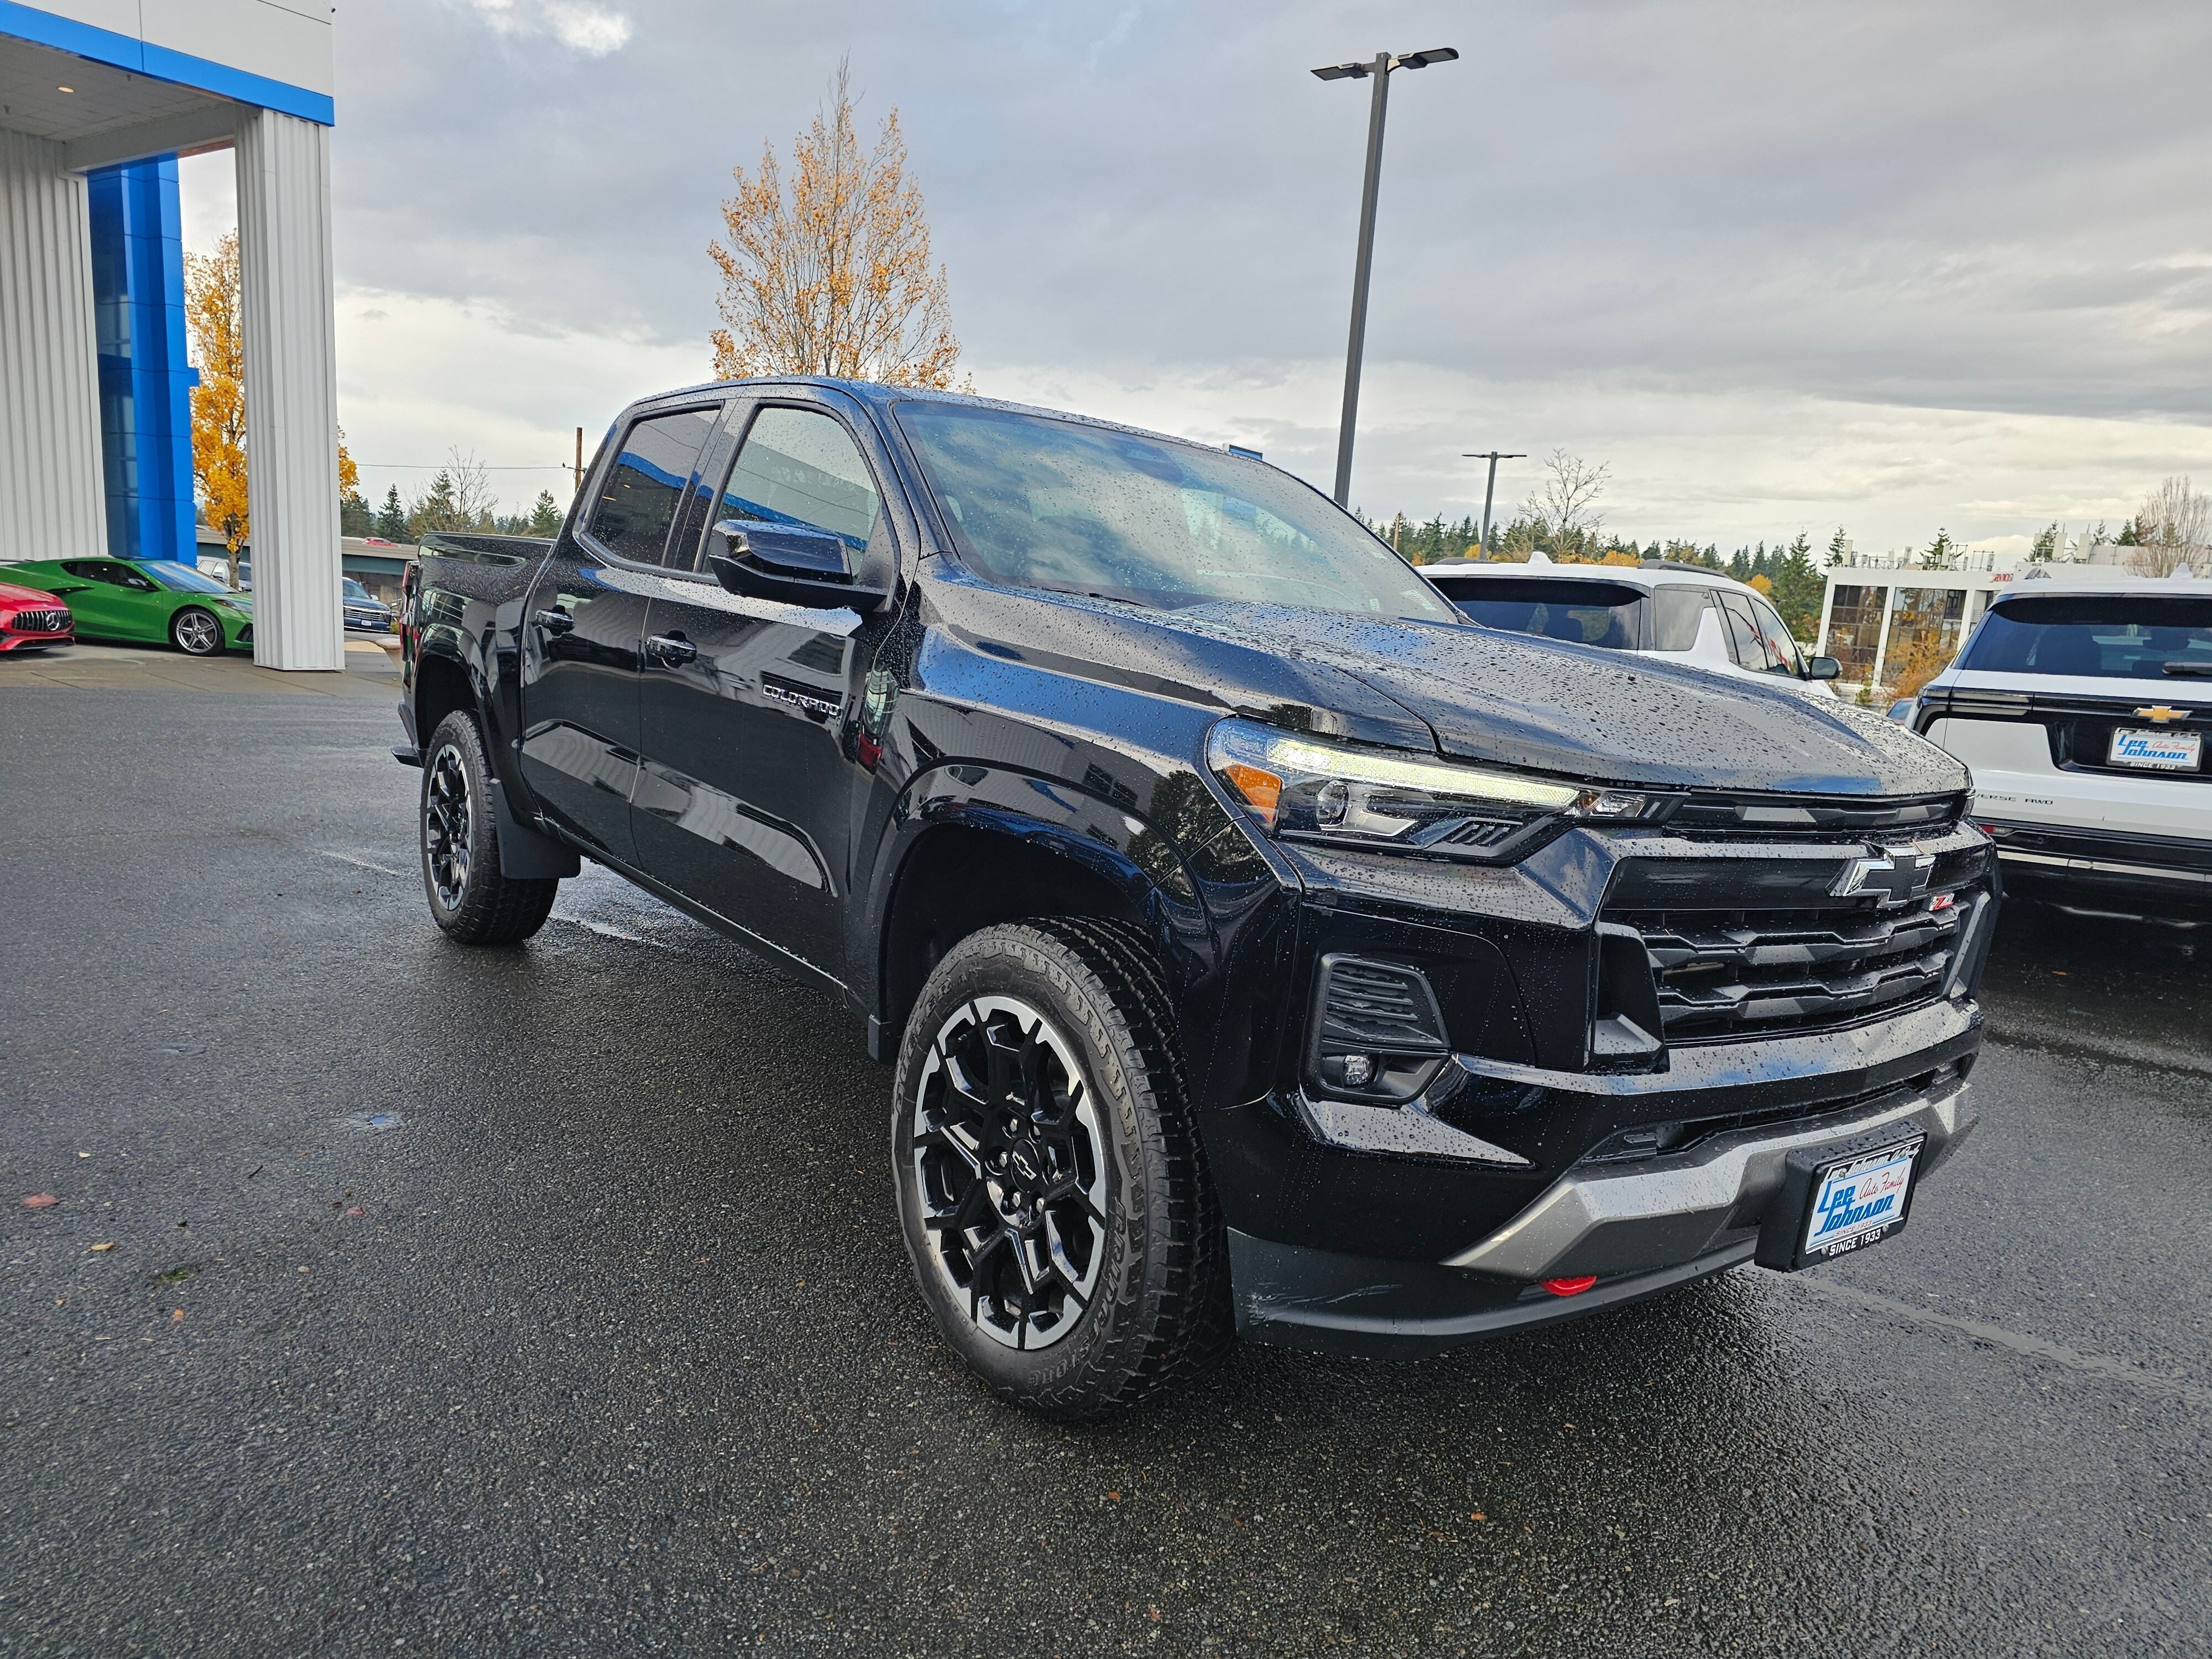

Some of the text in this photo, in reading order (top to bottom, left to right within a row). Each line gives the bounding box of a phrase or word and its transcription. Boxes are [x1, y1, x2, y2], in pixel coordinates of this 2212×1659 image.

[763, 685, 841, 716] COLORADO
[2117, 745, 2188, 760] Johnson
[2118, 735, 2148, 748] Lee
[2152, 741, 2196, 754] Auto Family
[1859, 1167, 1906, 1199] Auto Family
[1817, 1181, 1856, 1213] Lee
[1814, 1194, 1895, 1237] Johnson
[1835, 1220, 1872, 1237] SINCE 1933
[1829, 1229, 1880, 1256] SINCE 1933
